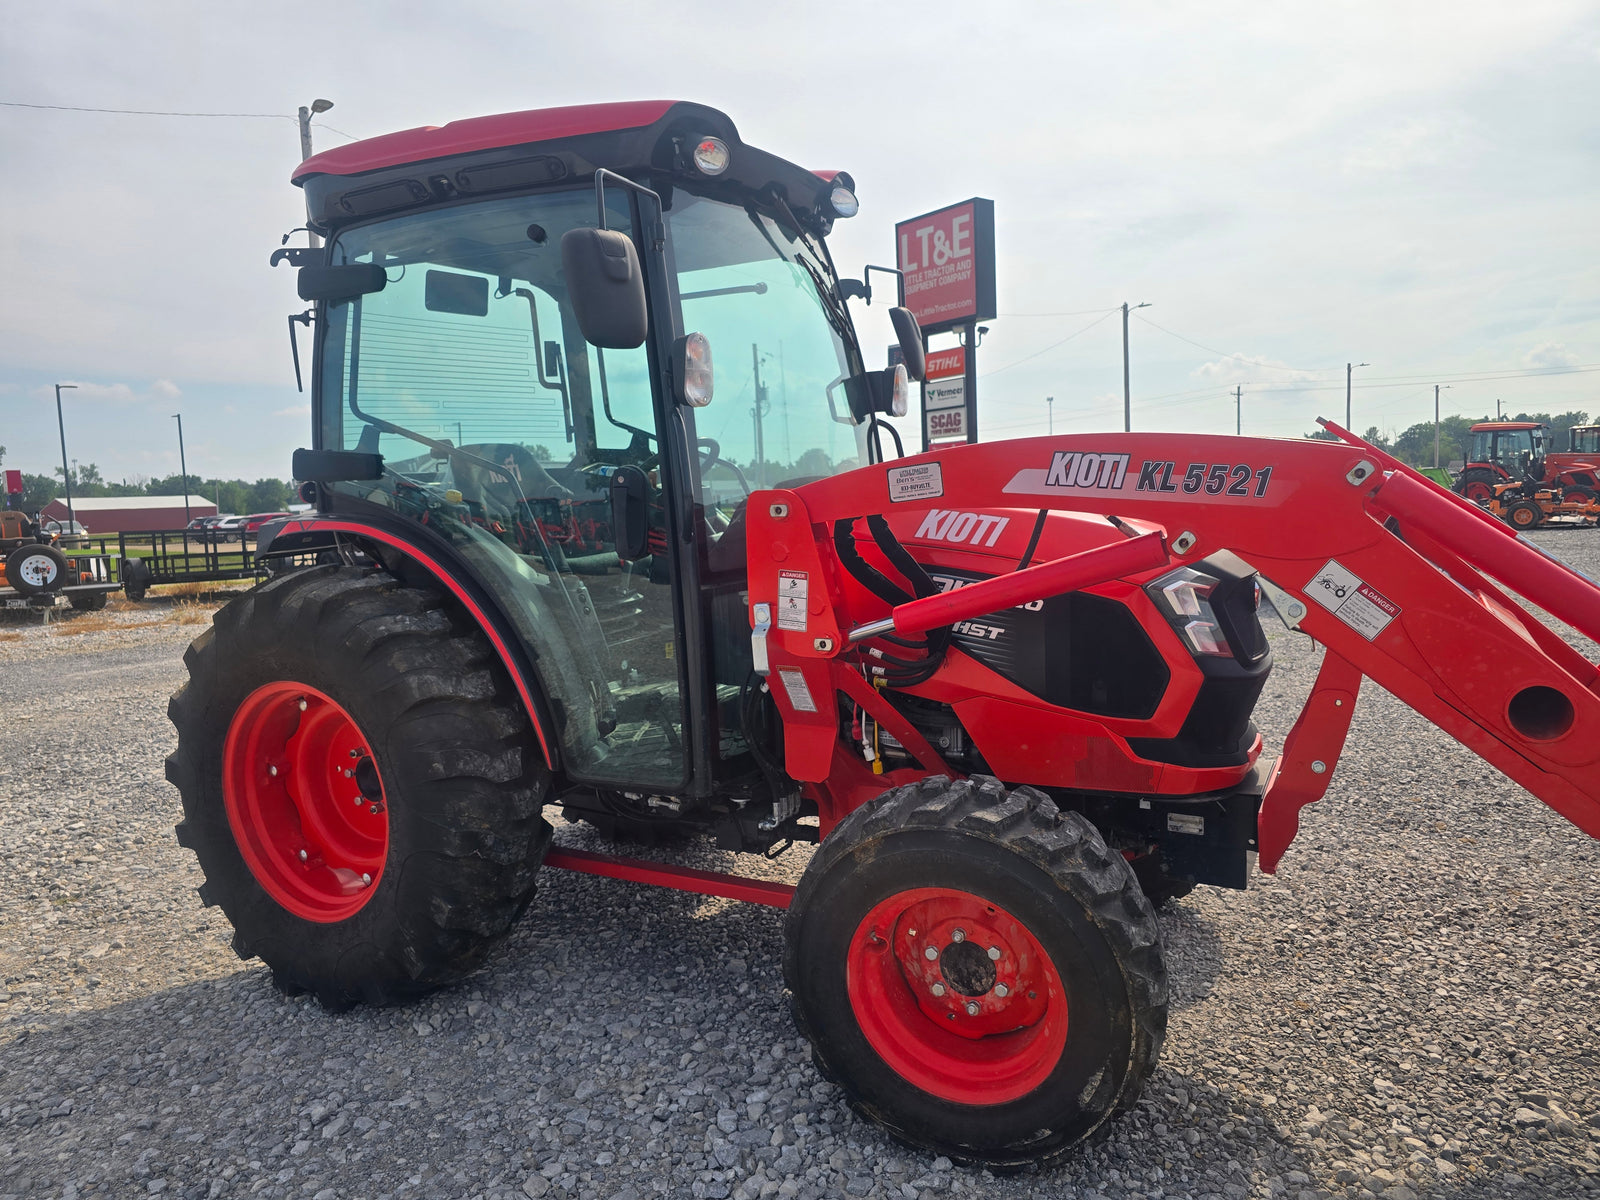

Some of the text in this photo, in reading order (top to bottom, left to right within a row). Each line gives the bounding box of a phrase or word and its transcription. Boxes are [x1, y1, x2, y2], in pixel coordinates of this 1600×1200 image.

[901, 213, 971, 273] LT&E
[905, 259, 972, 286] ITTLE TRACTOR AND
[938, 270, 971, 287] COMPANY
[927, 356, 961, 373] STIHL
[936, 387, 963, 398] Vermeer
[930, 412, 961, 429] SCAG
[1045, 450, 1131, 490] KIOTI
[914, 508, 1011, 548] KIOTI
[1367, 591, 1396, 613] DANGER
[952, 621, 1006, 640] HST
